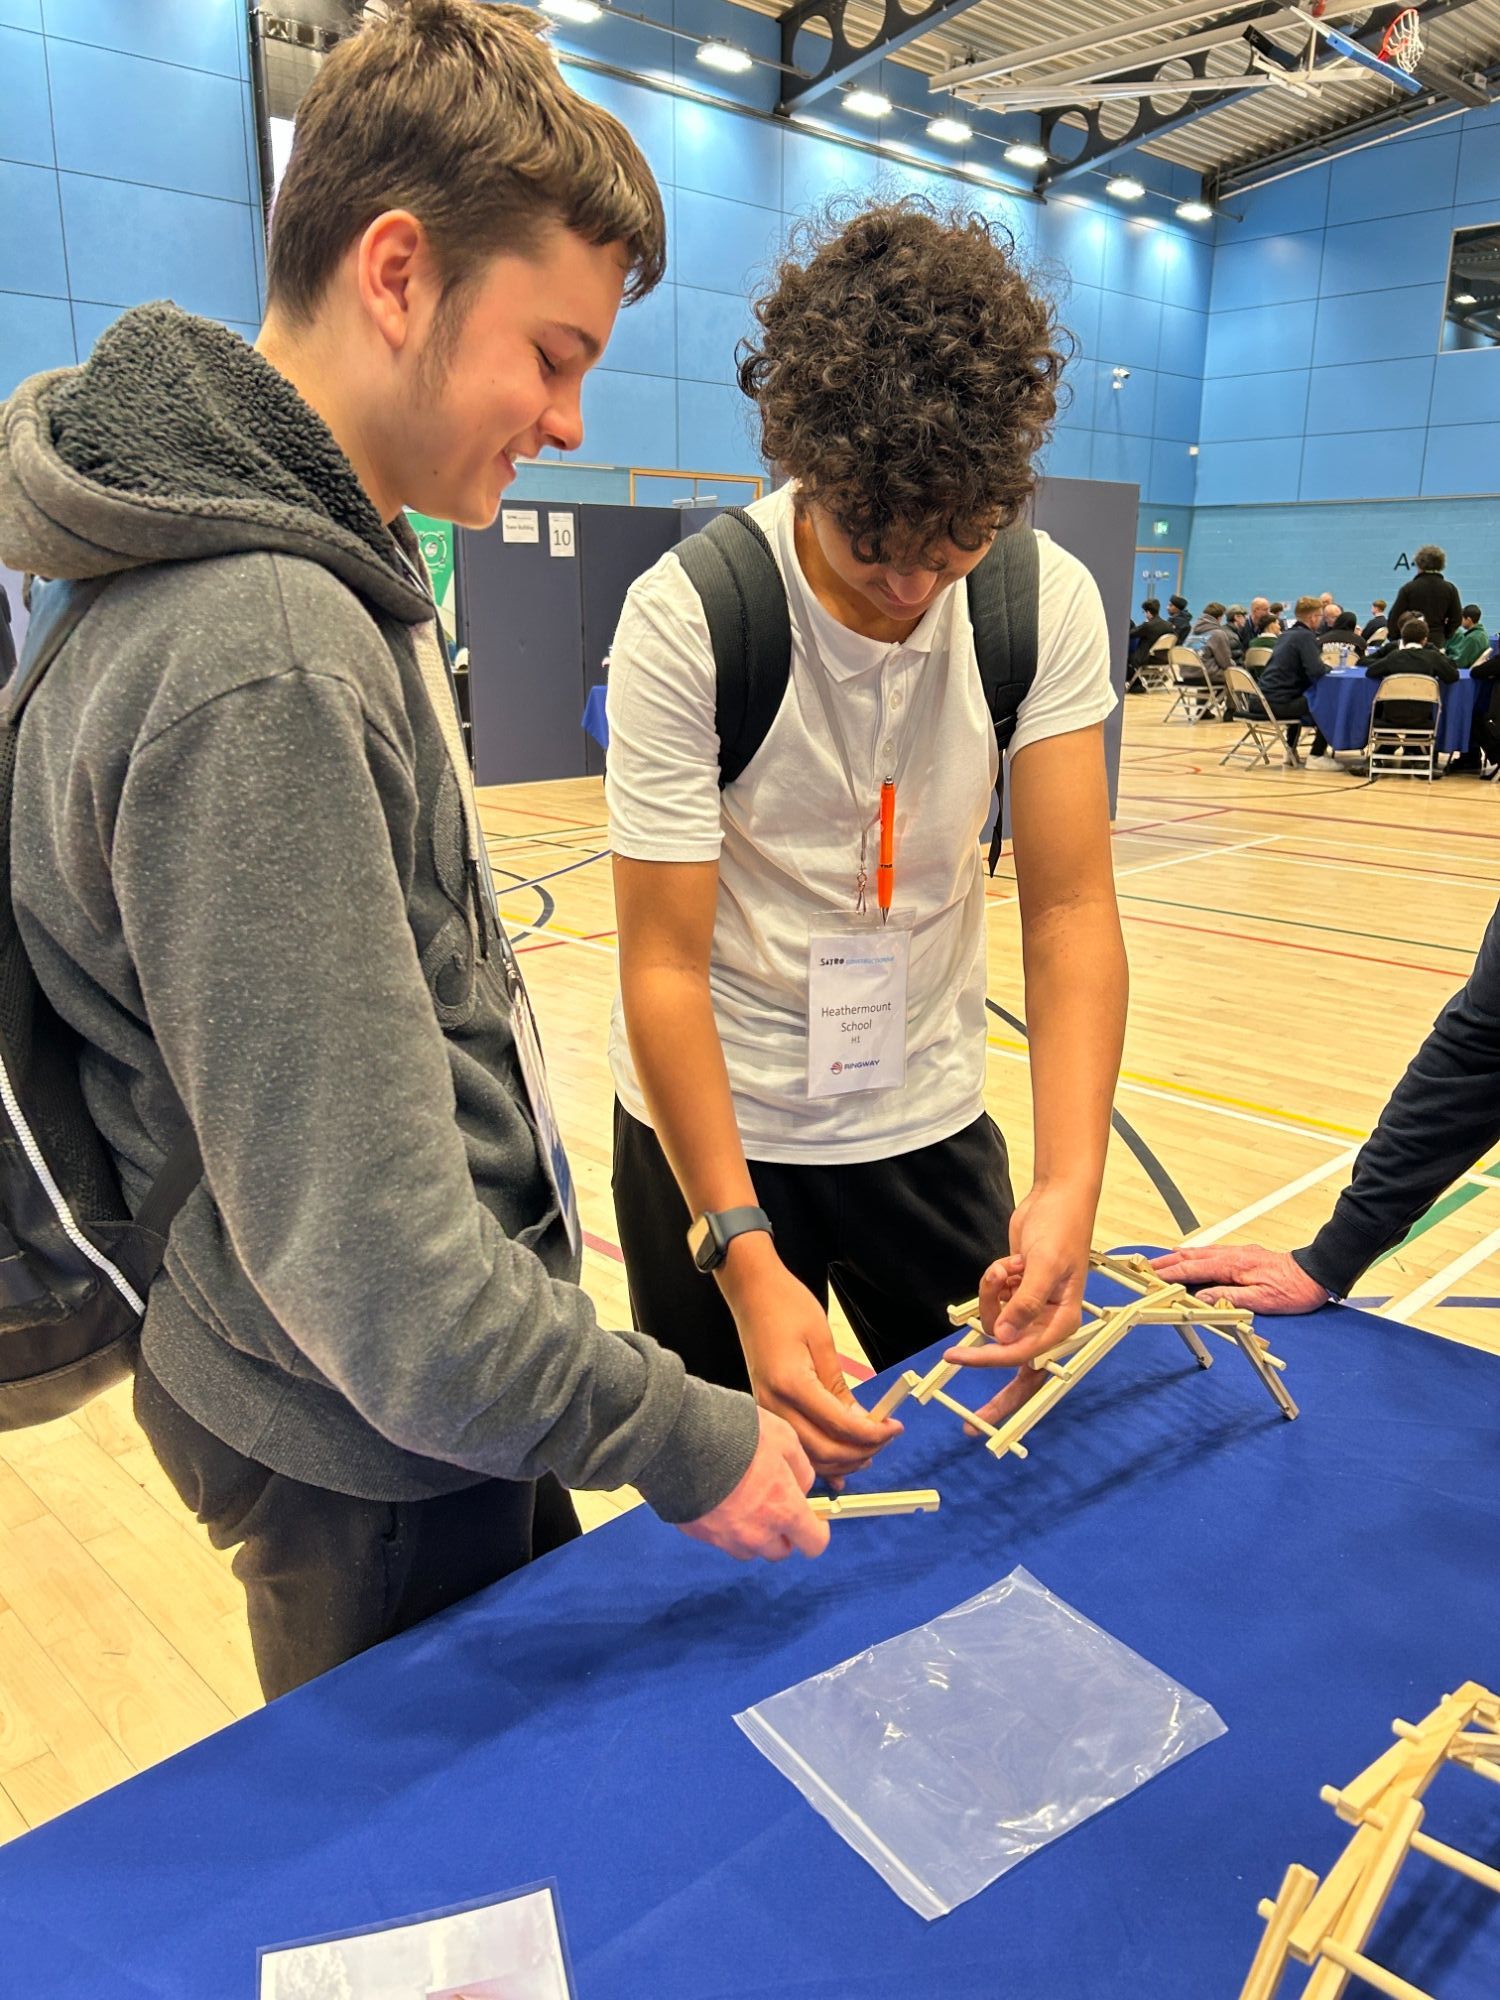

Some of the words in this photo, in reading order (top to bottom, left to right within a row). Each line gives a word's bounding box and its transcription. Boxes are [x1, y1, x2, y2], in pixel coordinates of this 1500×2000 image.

[553, 529, 571, 546] 10
[821, 1002, 892, 1017] Heathermount
[841, 1019, 872, 1032] School
[844, 1060, 880, 1070] RINGWAY
